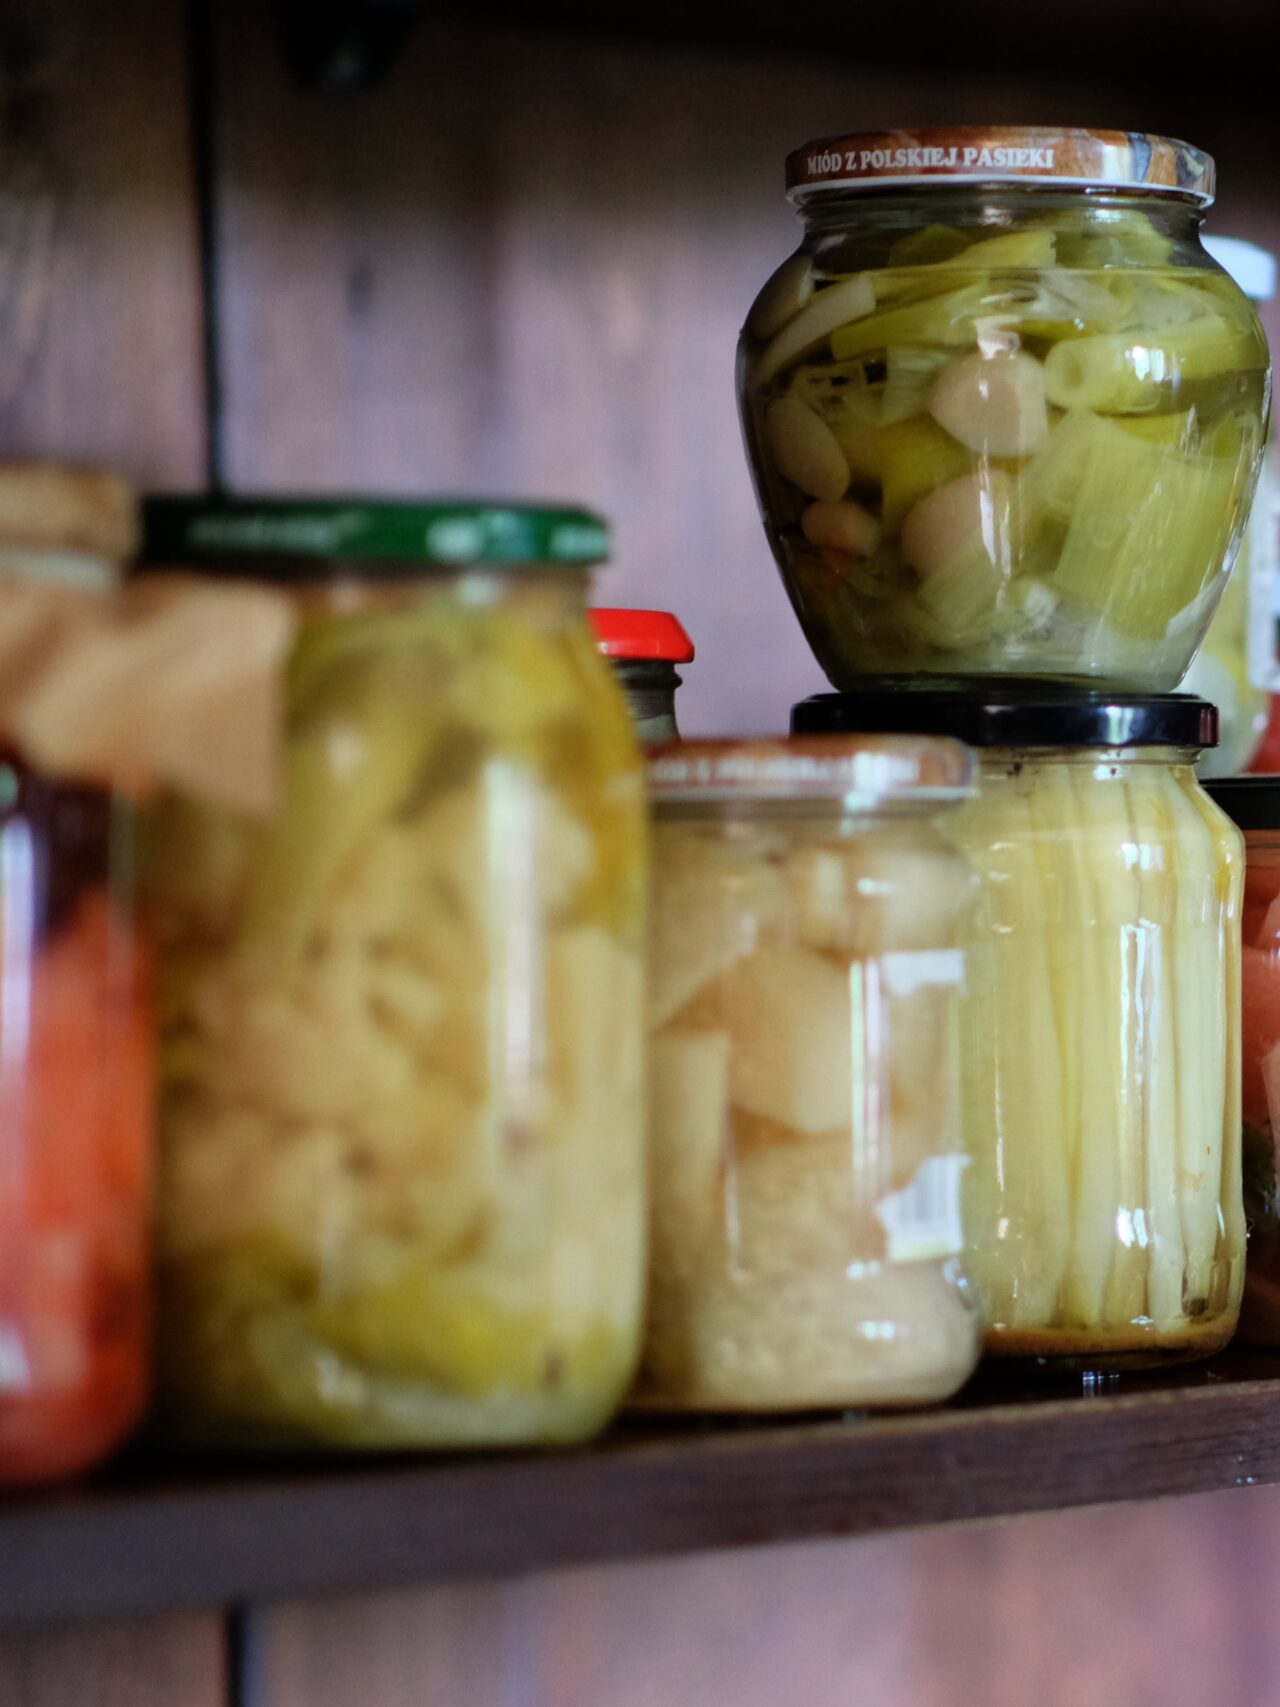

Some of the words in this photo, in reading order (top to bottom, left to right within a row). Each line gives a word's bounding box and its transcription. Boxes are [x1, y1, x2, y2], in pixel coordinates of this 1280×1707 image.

[807, 150, 842, 174] MIÓD
[845, 151, 857, 170] Z
[860, 147, 958, 168] POLSKIEJ
[962, 147, 1054, 168] PASIEKI
